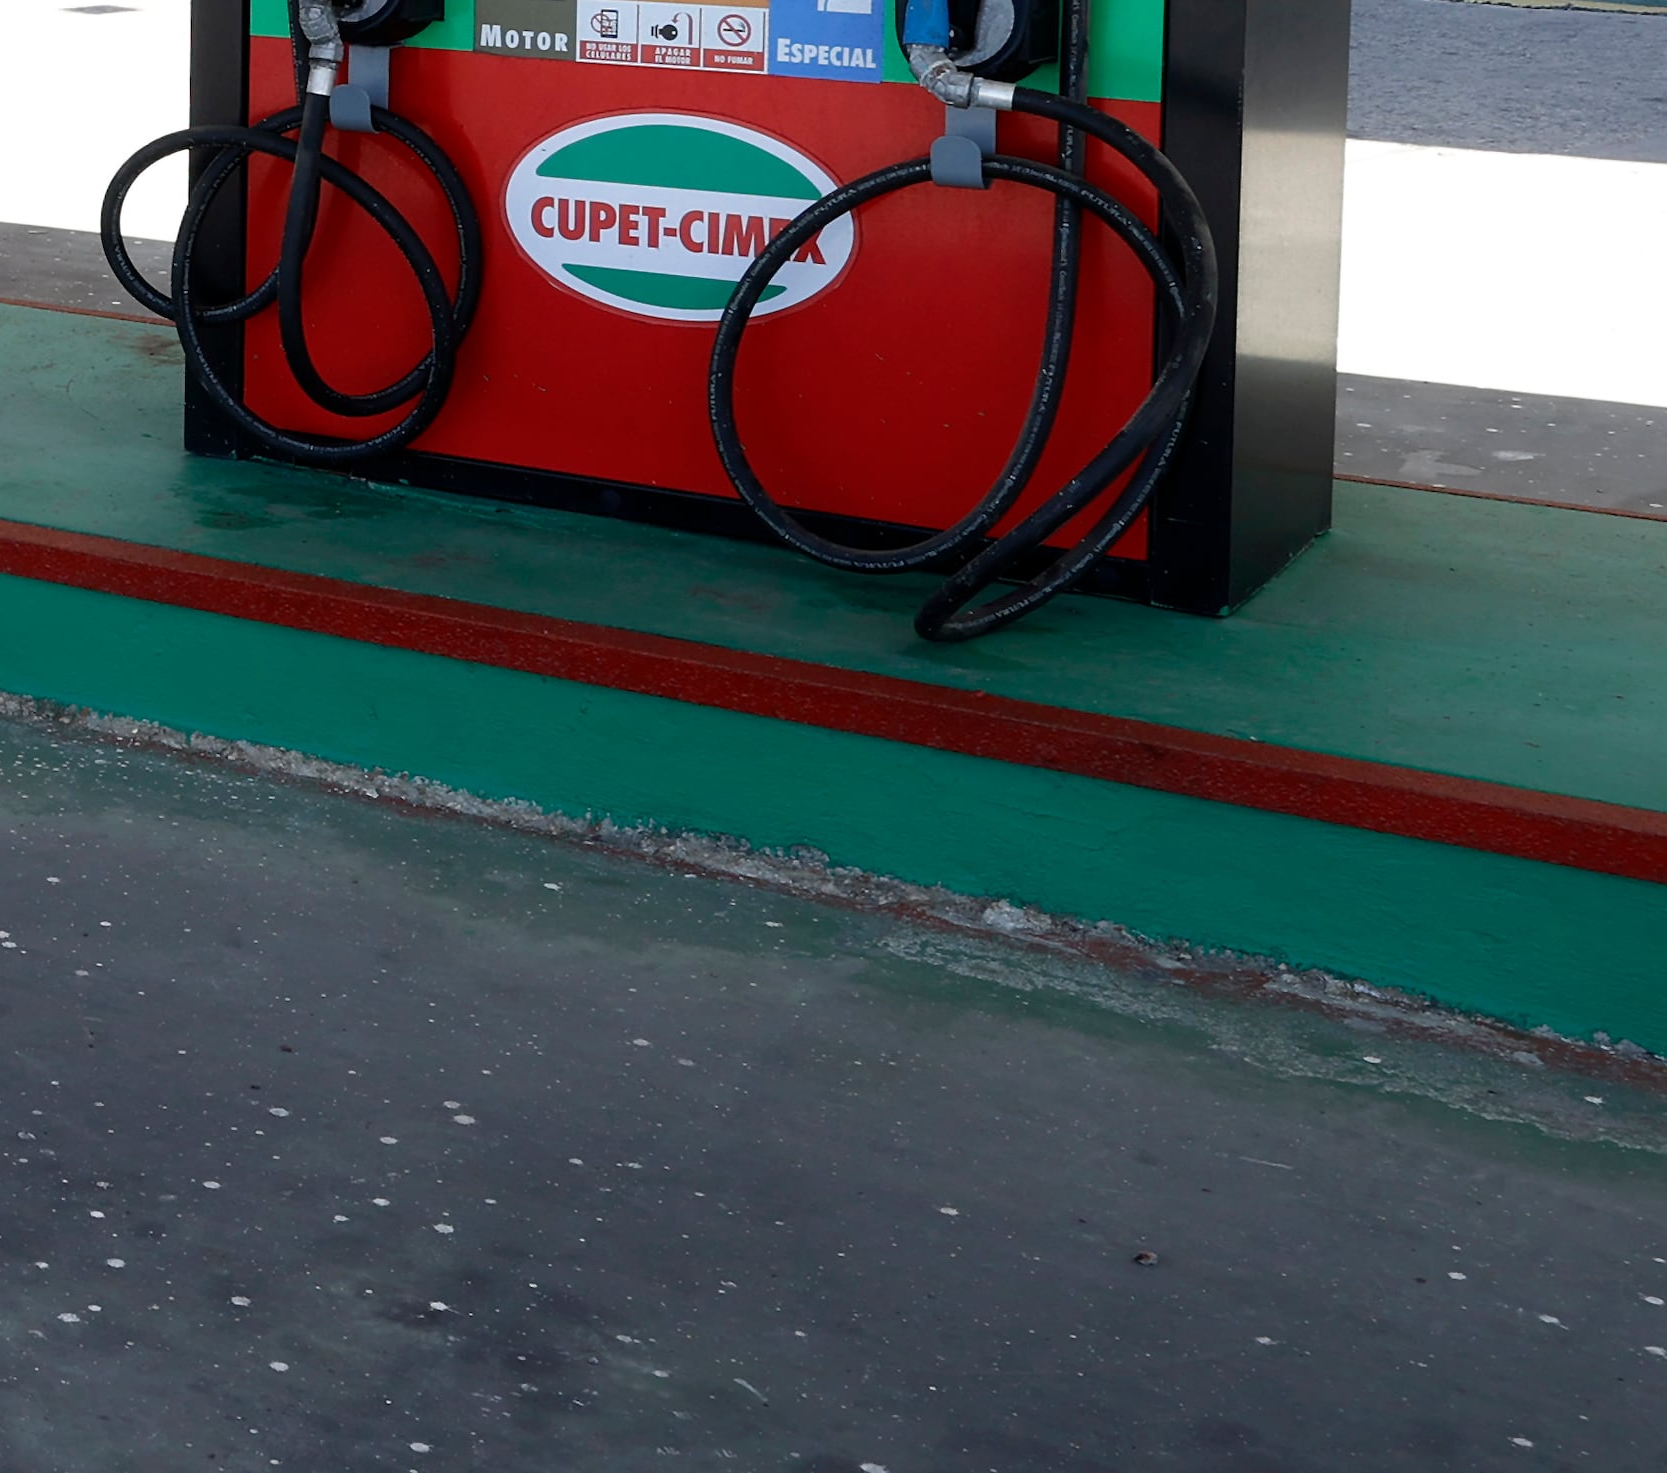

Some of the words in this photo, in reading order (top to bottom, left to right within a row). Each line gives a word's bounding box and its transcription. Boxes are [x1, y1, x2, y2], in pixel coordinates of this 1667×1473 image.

[480, 24, 568, 52] MOTOR
[586, 43, 597, 51] NO
[598, 43, 617, 52] USAR
[619, 44, 631, 53] LOS
[654, 48, 691, 57] APAGAR
[586, 51, 632, 61] CELULARES
[776, 38, 876, 70] ESPECIAL
[665, 56, 691, 64] MOTOR
[714, 55, 725, 63] NO
[727, 56, 754, 65] FUMAR
